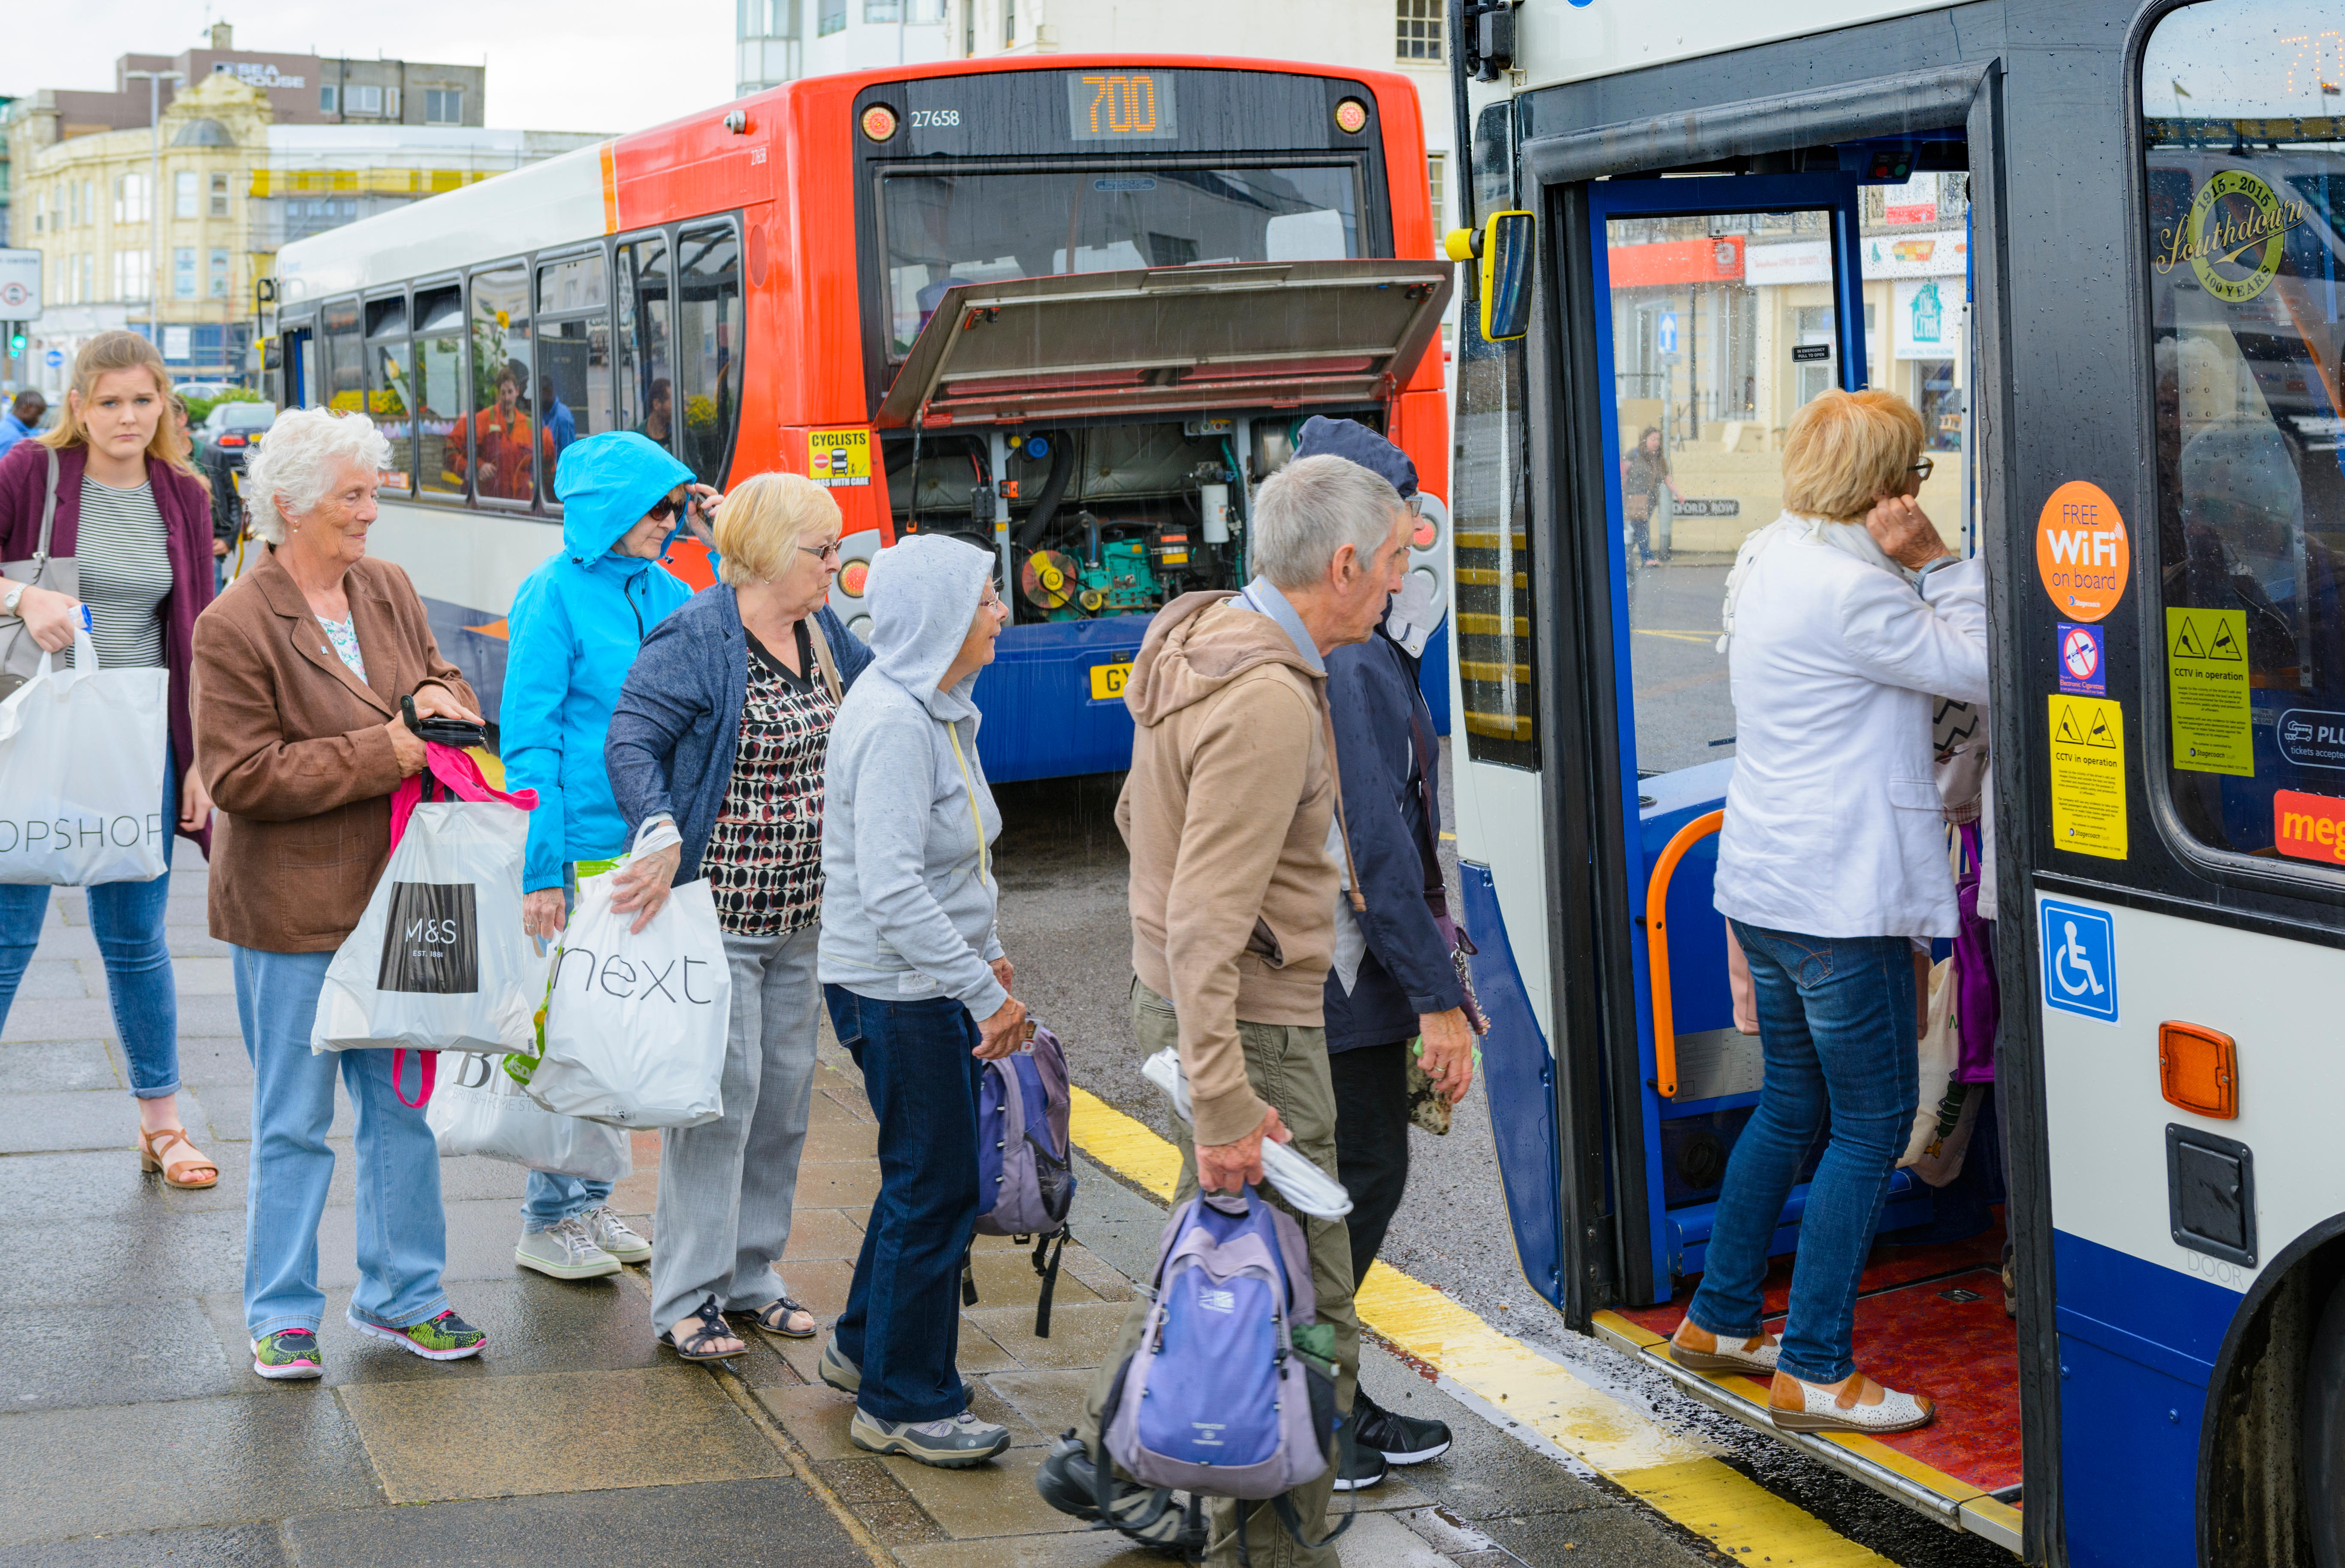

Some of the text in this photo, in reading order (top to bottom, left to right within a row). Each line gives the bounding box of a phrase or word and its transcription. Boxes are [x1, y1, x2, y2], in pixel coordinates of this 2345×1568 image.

[238, 62, 280, 76] SEA
[1083, 76, 1156, 132] 700
[912, 111, 960, 127] 27658
[2197, 178, 2226, 213] 1915
[2239, 177, 2271, 207] 2015
[2156, 198, 2311, 274] Southdown
[2204, 264, 2271, 297] 100 YEARS
[812, 433, 866, 446] CYCLISTS
[831, 478, 850, 487] WITH
[851, 476, 869, 486] CARE
[1712, 502, 1736, 514] ROW
[2063, 504, 2098, 525] FREE
[2046, 529, 2116, 567] WiFi
[2052, 568, 2116, 590] on board
[2075, 600, 2101, 608] Stagecoach
[2174, 668, 2243, 681] CCTV in operation
[2060, 679, 2104, 690] Electronic Cigarettes
[2056, 753, 2117, 768] CCTV in operation
[2197, 749, 2225, 758] Stagecoach
[2291, 746, 2345, 760] tickets accepte
[2075, 829, 2101, 839] Stagecoach
[405, 918, 456, 944] M&S
[553, 947, 712, 1004] next
[453, 1087, 486, 1106] BRITISH
[489, 1096, 515, 1111] HOME
[2188, 1249, 2244, 1289] DOOR
